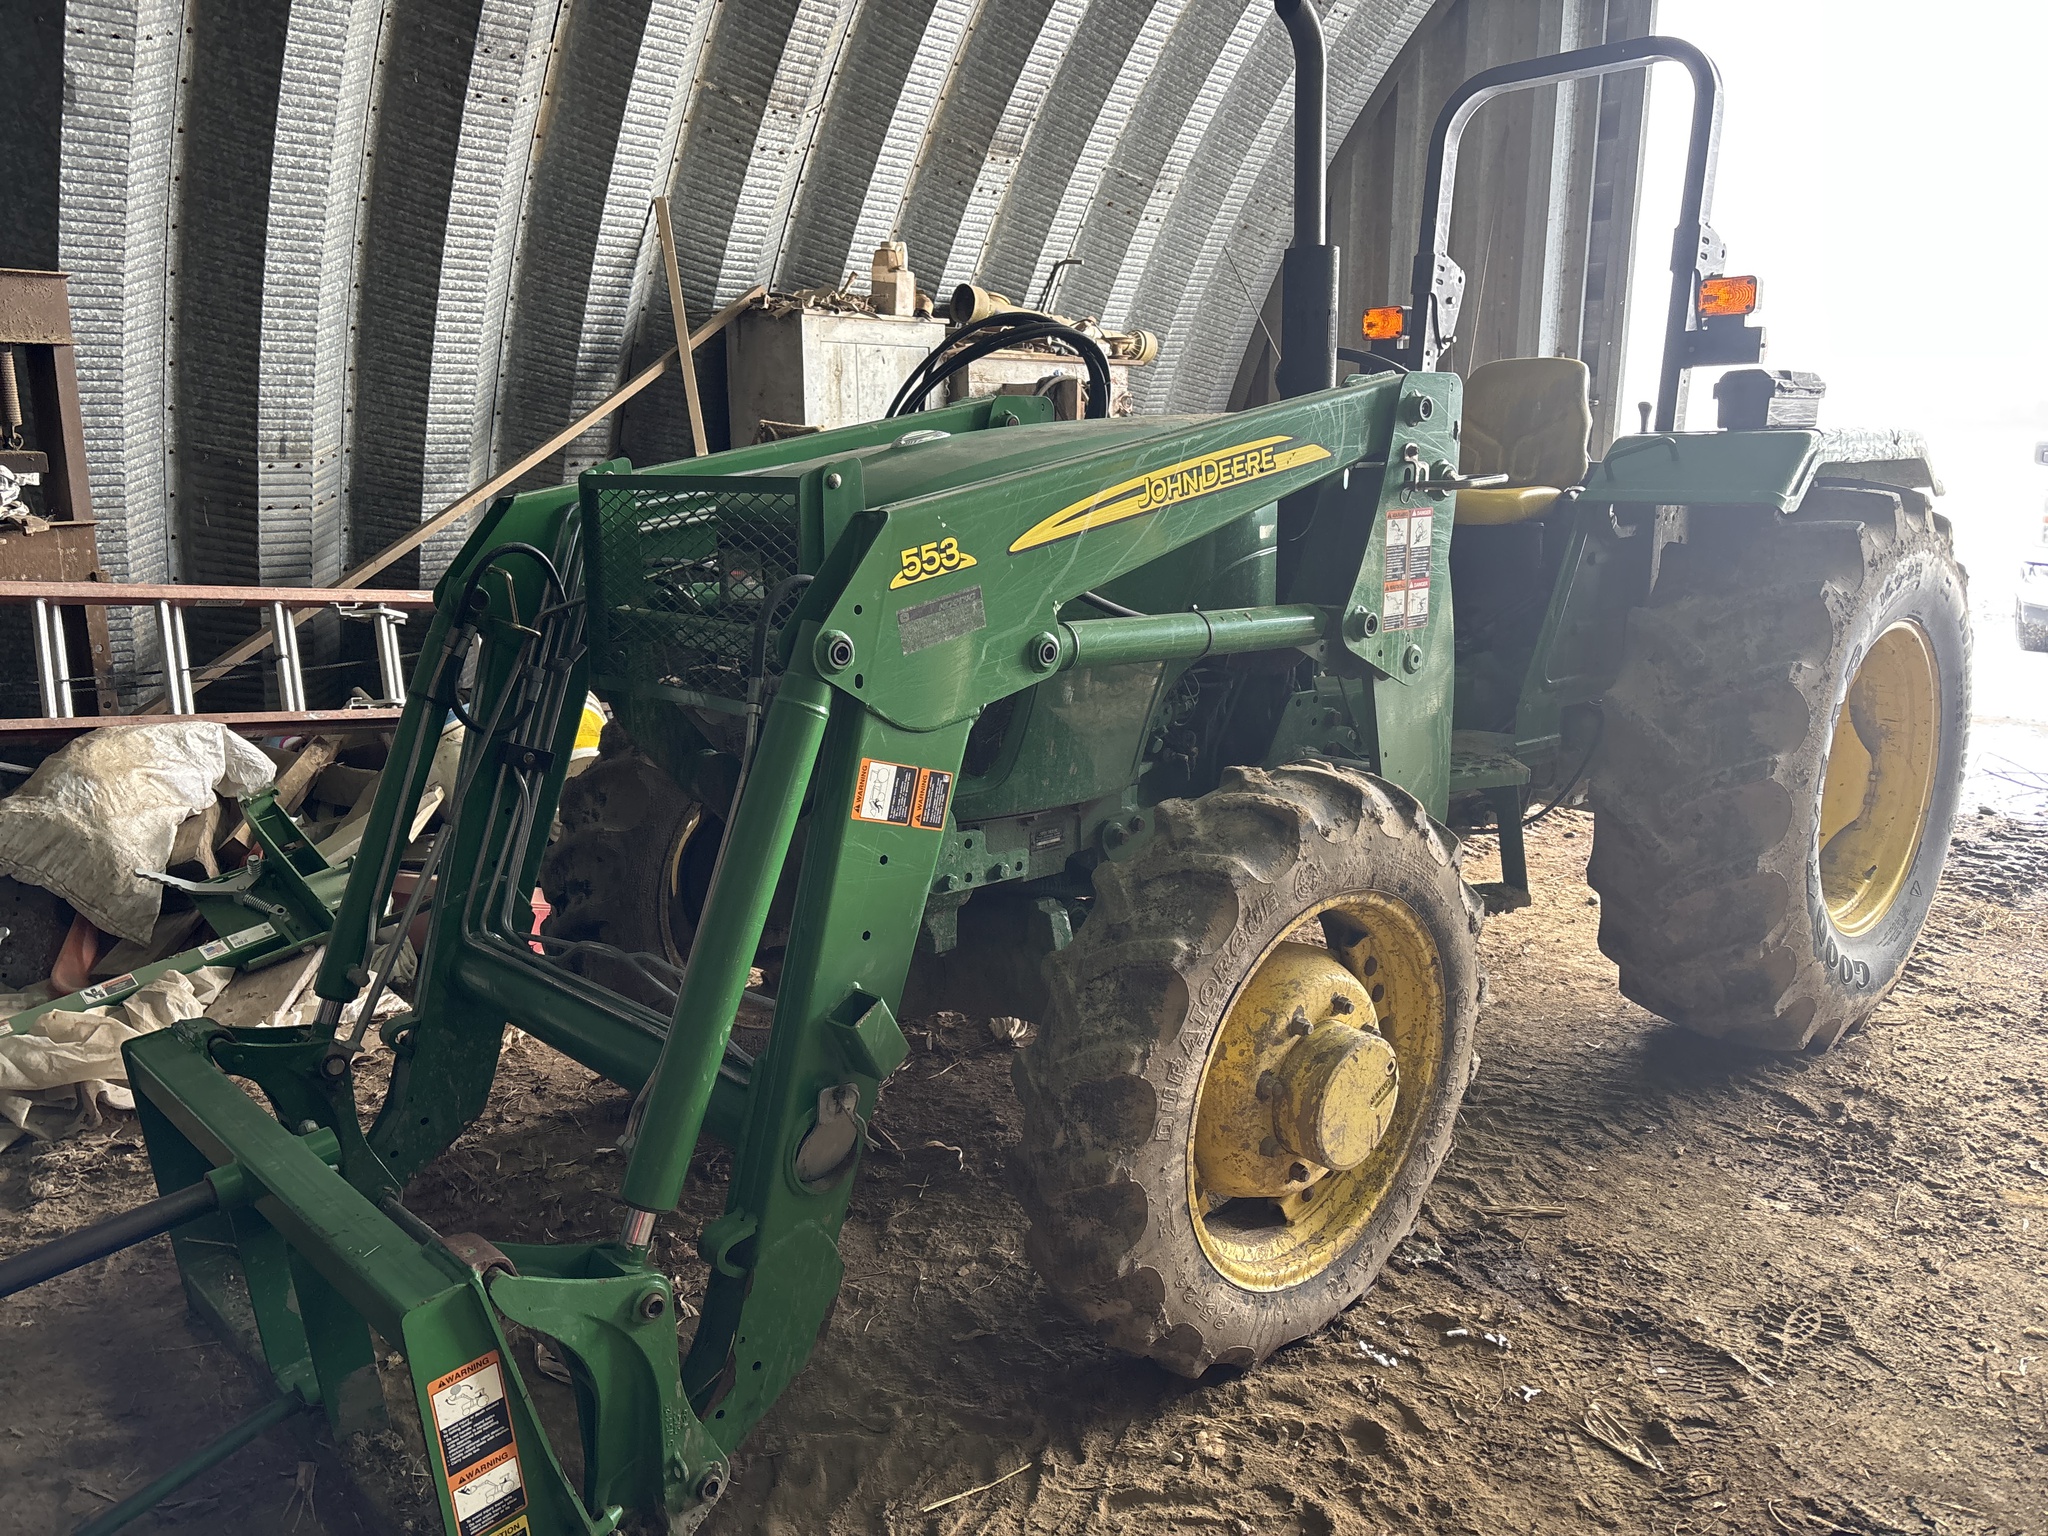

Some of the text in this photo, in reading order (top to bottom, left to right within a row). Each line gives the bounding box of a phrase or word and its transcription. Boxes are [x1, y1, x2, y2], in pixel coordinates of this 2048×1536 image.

[1138, 446, 1278, 509] JOHN DEERE
[901, 537, 961, 579] 553
[856, 765, 868, 803] WARNING
[917, 774, 928, 811] WARNING
[446, 1357, 490, 1384] WARNING
[466, 1452, 509, 1480] WARNING
[496, 1522, 520, 1536] TION
